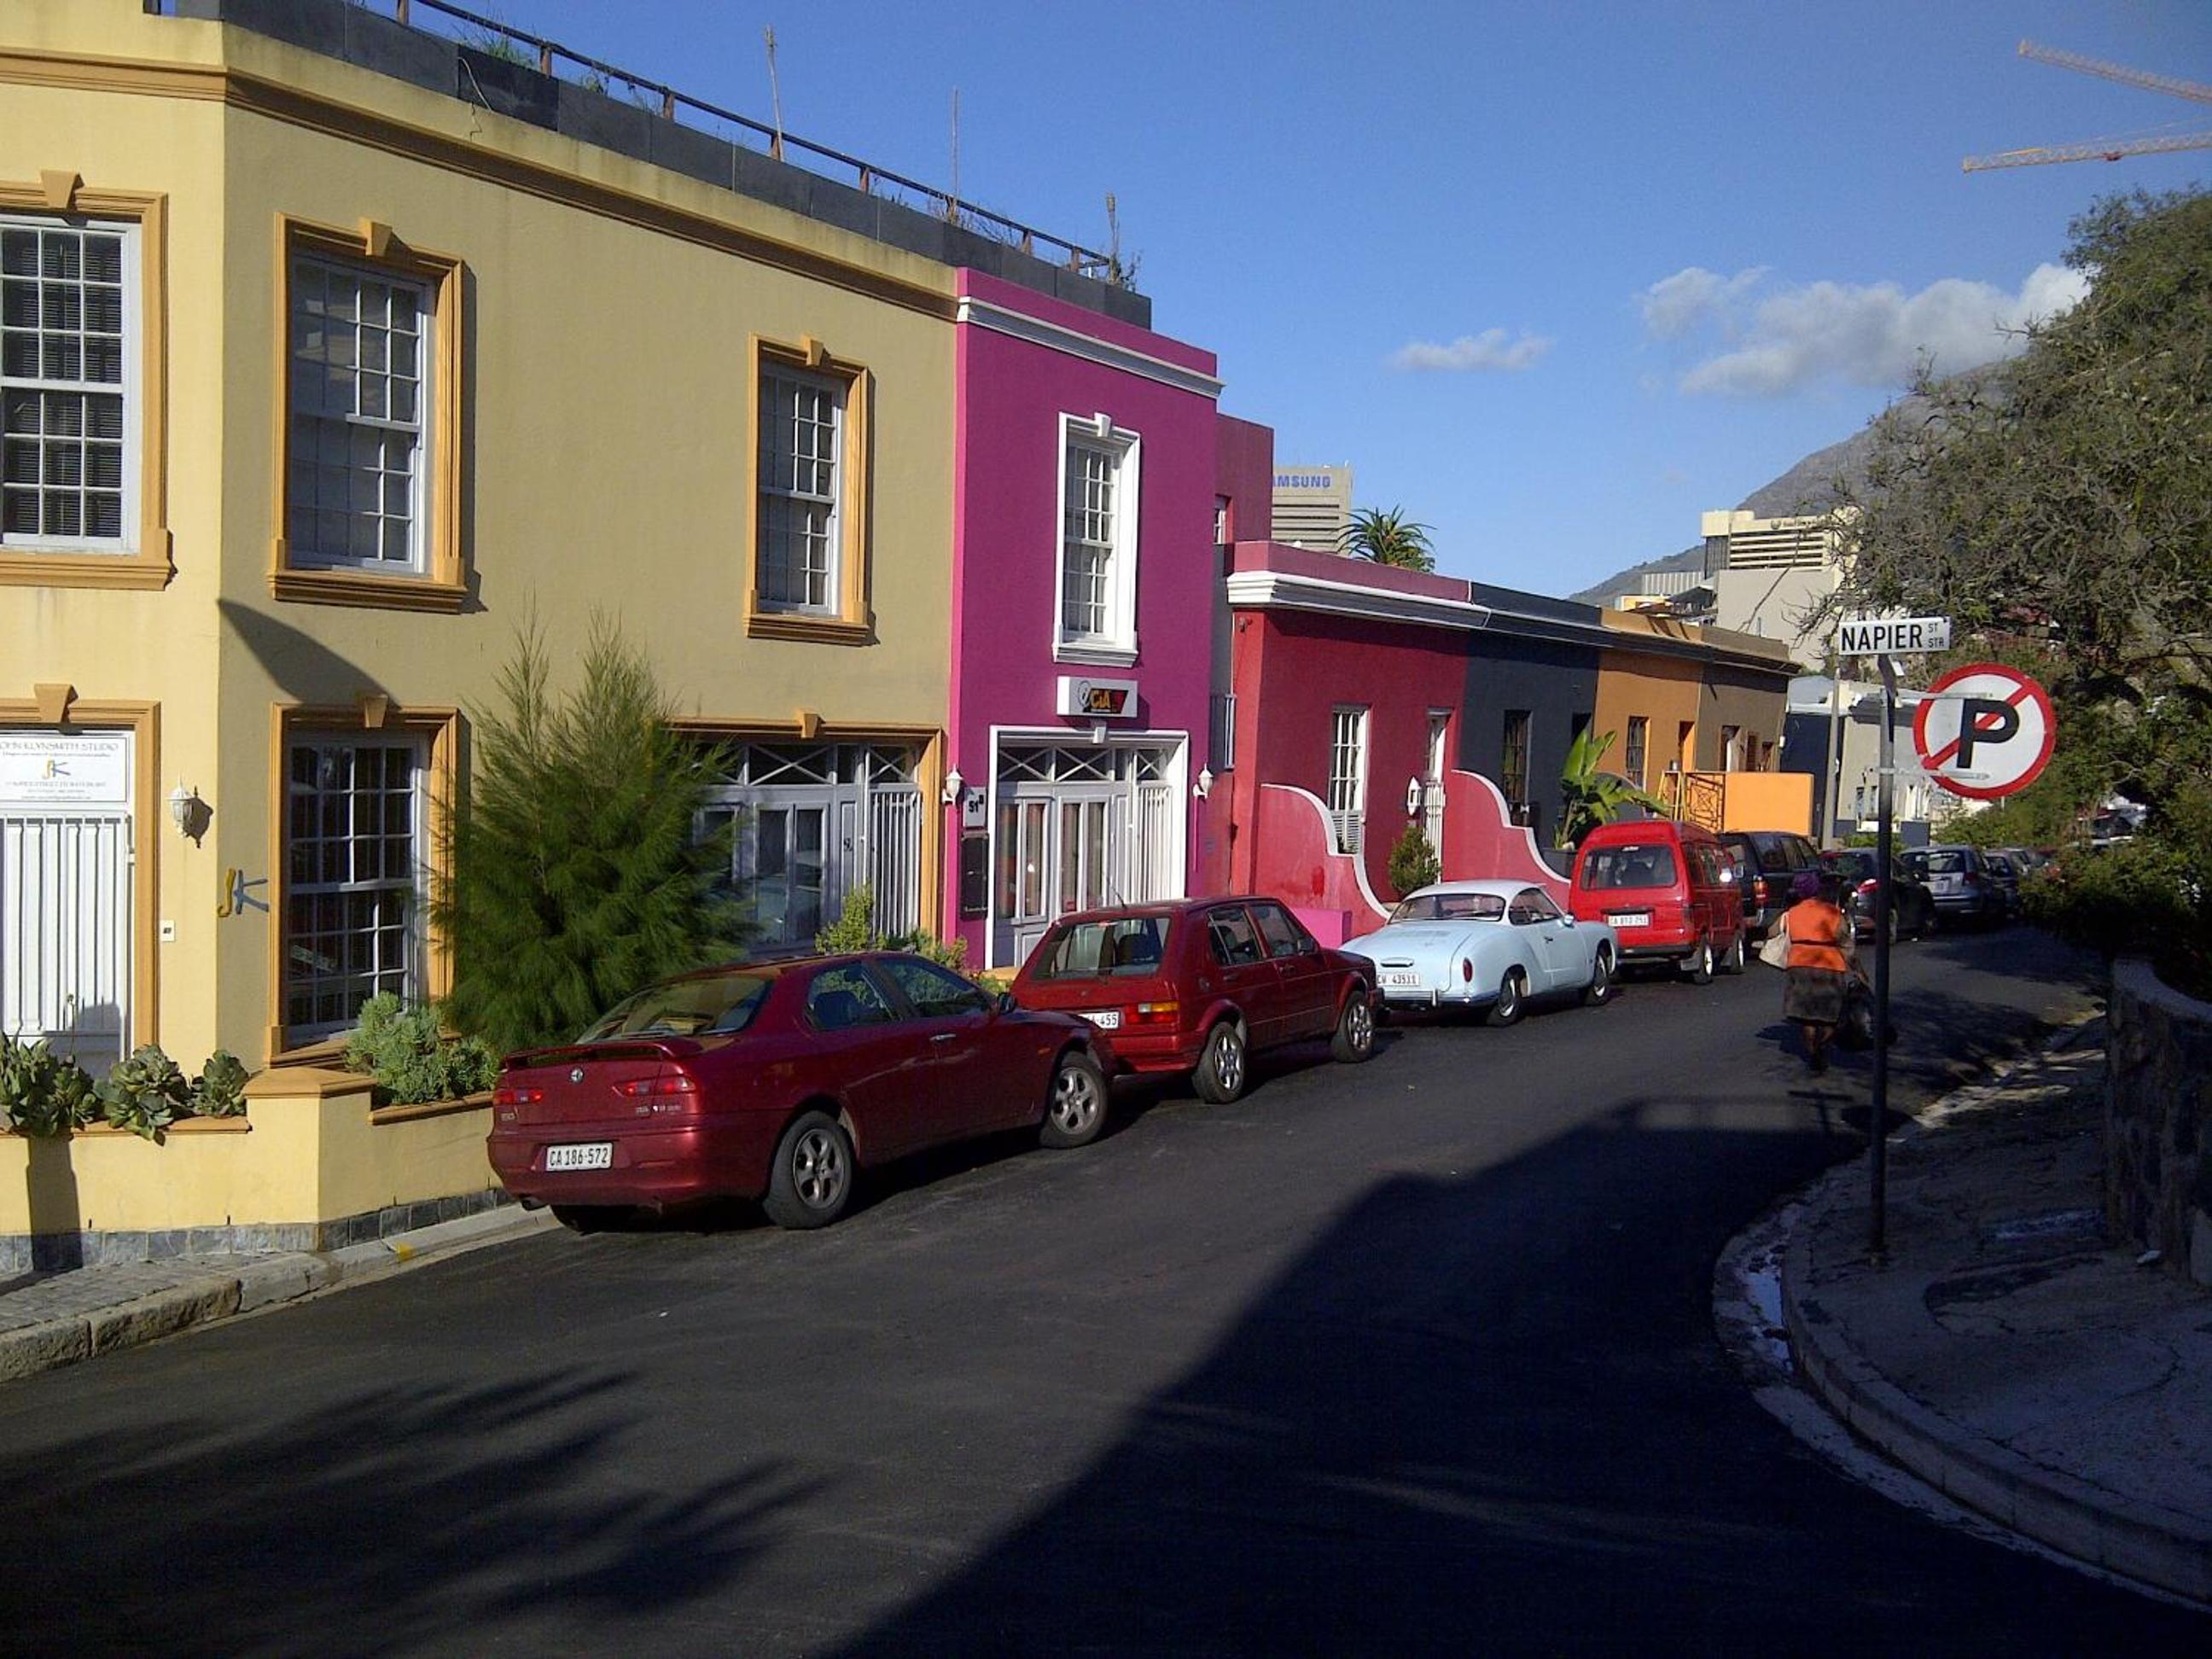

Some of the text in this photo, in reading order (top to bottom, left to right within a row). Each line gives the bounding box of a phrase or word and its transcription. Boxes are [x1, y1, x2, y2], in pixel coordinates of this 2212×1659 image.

[1929, 623, 1938, 632] ST
[1842, 625, 1922, 650] NAPIER
[1928, 637, 1944, 648] STR
[1957, 698, 2019, 769] P
[550, 1150, 562, 1166] CA
